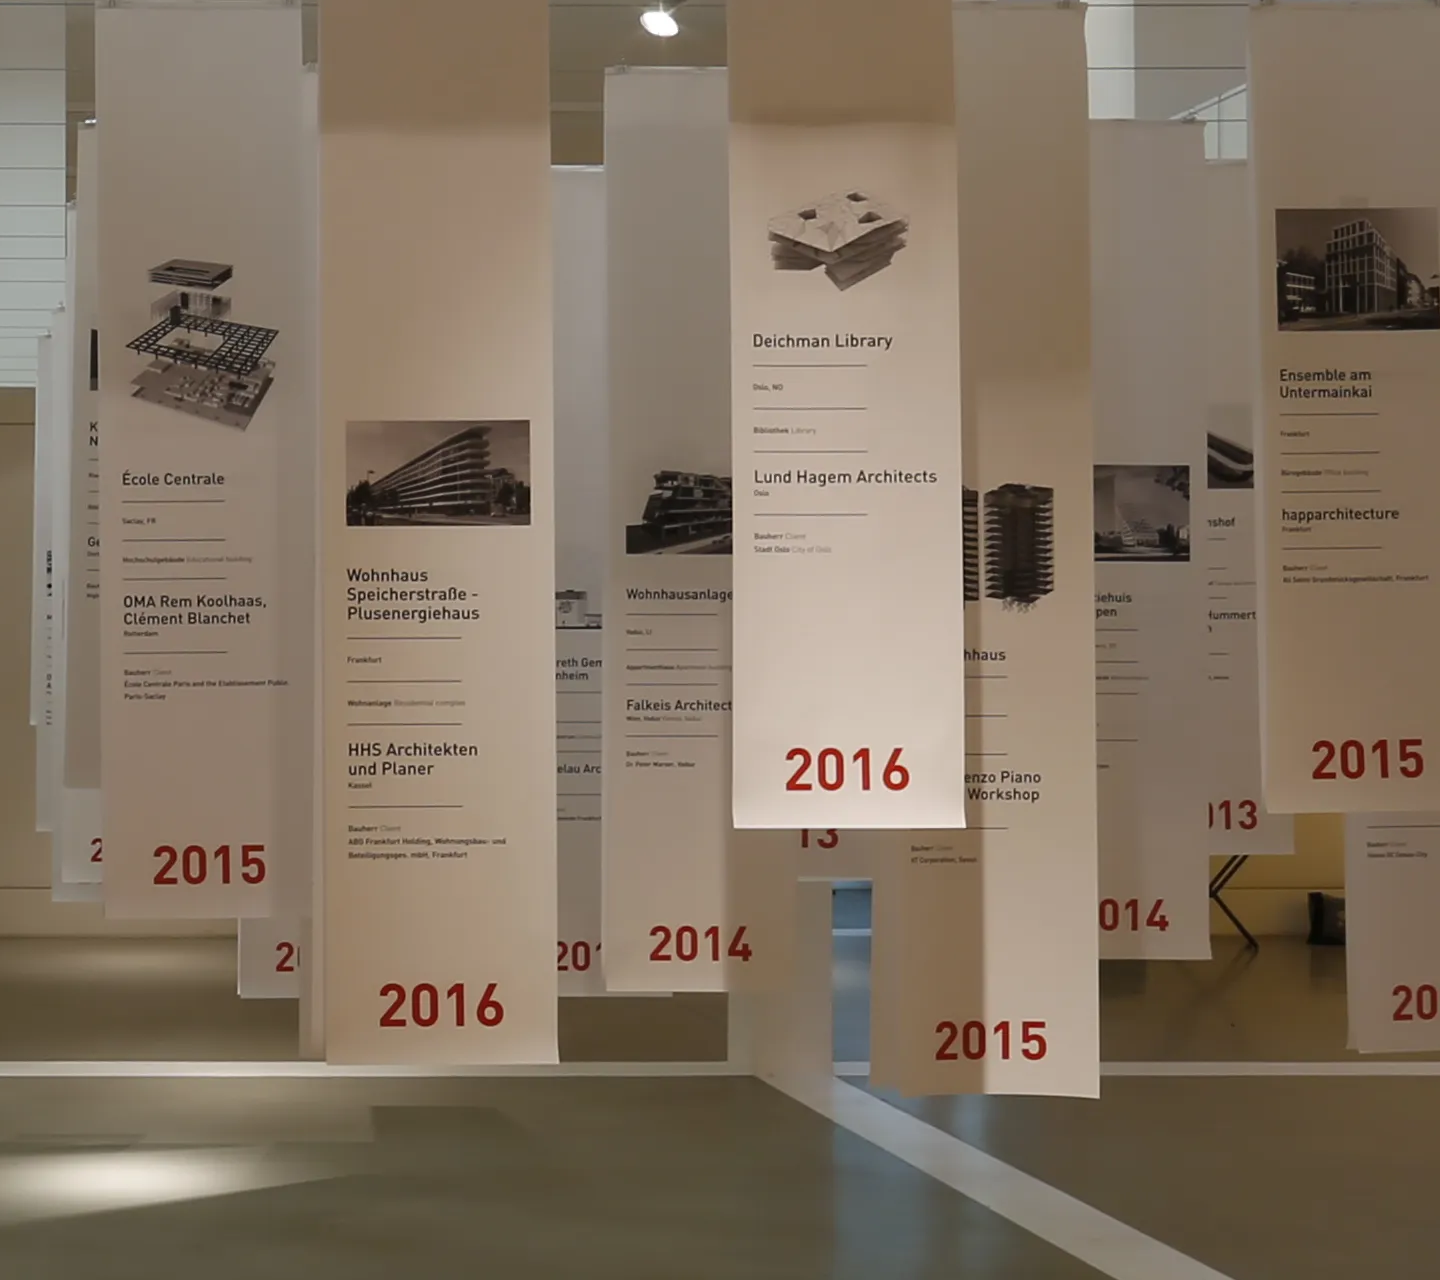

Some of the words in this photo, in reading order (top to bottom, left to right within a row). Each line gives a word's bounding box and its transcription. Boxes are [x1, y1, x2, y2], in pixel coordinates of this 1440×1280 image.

[754, 334, 830, 348] Deichman
[836, 334, 892, 350] Library
[1280, 369, 1346, 381] Ensemble
[1349, 371, 1372, 381] am
[752, 383, 771, 392] Oslo,
[771, 383, 784, 391] NO
[1280, 386, 1371, 398] Untermainkai
[753, 426, 790, 434] Bibliothek
[123, 470, 159, 485] École
[164, 473, 224, 485] Centrale
[755, 470, 791, 483] Lund
[797, 470, 851, 487] Hagem
[856, 470, 937, 483] Architects
[753, 489, 770, 497] Oslo
[1282, 508, 1399, 523] happarchitecture
[347, 568, 428, 582] Wohnhaus
[124, 596, 156, 608] OMA
[161, 595, 192, 607] Rem
[197, 595, 266, 608] Koolhaas,
[347, 587, 466, 604] Speicherstraße
[626, 589, 732, 602] Wohnhausanlage
[124, 612, 182, 625] Clément
[188, 612, 250, 624] Blanchet
[348, 606, 479, 623] Plusenergiehaus
[346, 655, 382, 664] Frankfurt
[347, 699, 392, 709] Wohnanlage
[627, 699, 671, 711] Falkeis
[675, 700, 732, 712] Architect
[349, 743, 382, 756] HHS
[386, 743, 477, 756] Architekten
[1312, 739, 1423, 779] 2015
[349, 762, 376, 775] und
[382, 762, 434, 775] Planer
[786, 748, 909, 791] 2016
[1001, 771, 1041, 783] Piano
[347, 781, 373, 790] Kassel
[967, 786, 1039, 803] Workshop
[364, 837, 401, 846] Frankfurt
[431, 851, 468, 859] Frankfurt
[154, 845, 265, 884] 2015
[650, 926, 753, 962] 2014
[380, 983, 503, 1027] 2016
[932, 1020, 1046, 1064] 2015
